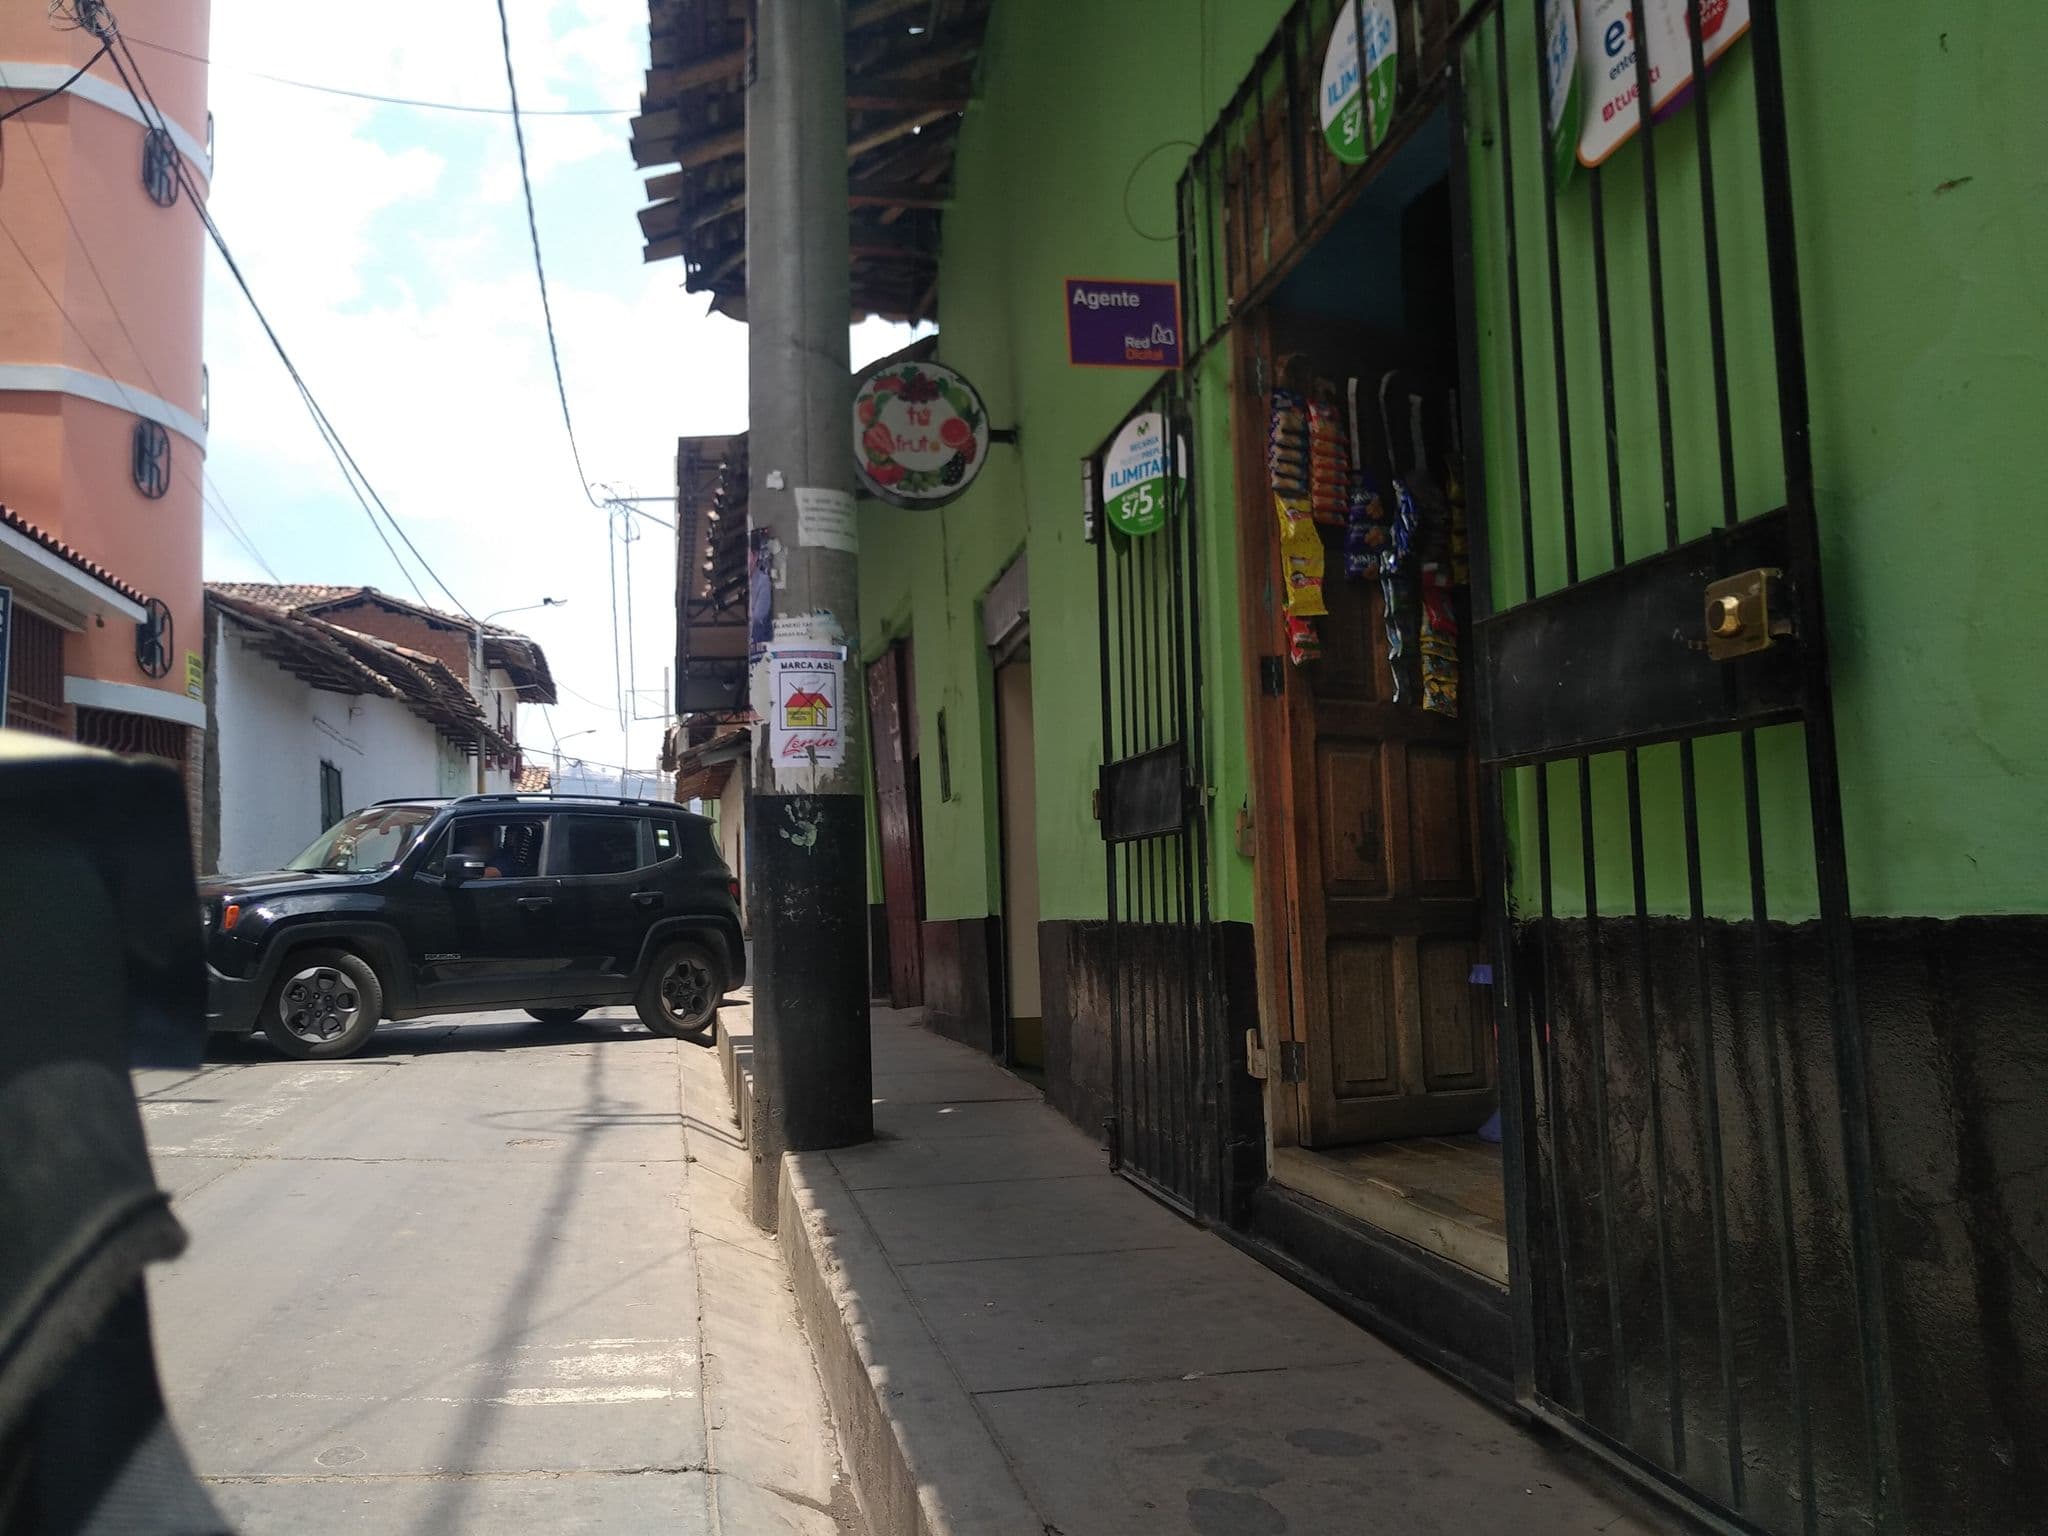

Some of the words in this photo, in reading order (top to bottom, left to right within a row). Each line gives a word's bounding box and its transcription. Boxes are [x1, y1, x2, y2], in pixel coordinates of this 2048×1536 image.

[1614, 65, 1661, 112] tueti
[1073, 288, 1140, 310] Agente
[1124, 336, 1151, 349] Red
[780, 661, 814, 670] MARCA
